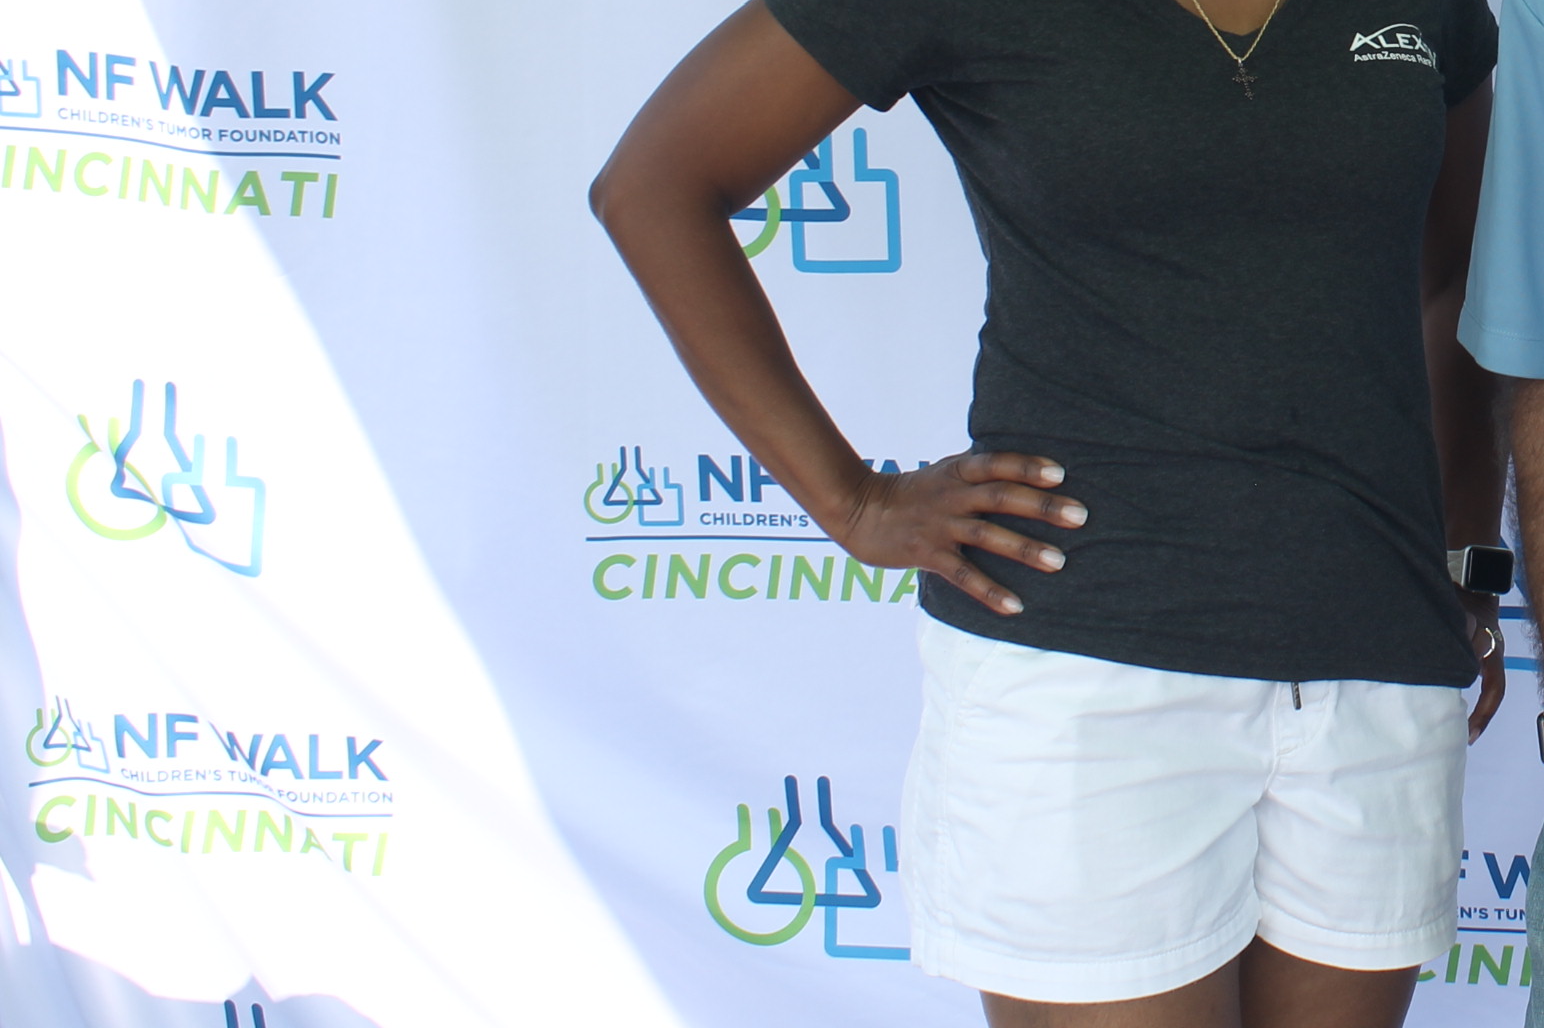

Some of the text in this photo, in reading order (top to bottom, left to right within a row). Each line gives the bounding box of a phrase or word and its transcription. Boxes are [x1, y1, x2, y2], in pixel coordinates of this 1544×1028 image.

[56, 49, 338, 121] NF WALK
[58, 107, 341, 145] CHILDREN'S TUMOR FOUNDATION
[1, 144, 338, 219] INCINNATI
[700, 512, 809, 527] CHILDREN'S
[114, 713, 389, 781] NF WALK
[121, 768, 221, 783] CHILDREN'S
[277, 789, 393, 803] FOUNDATION
[35, 794, 388, 876] CINCINNATI
